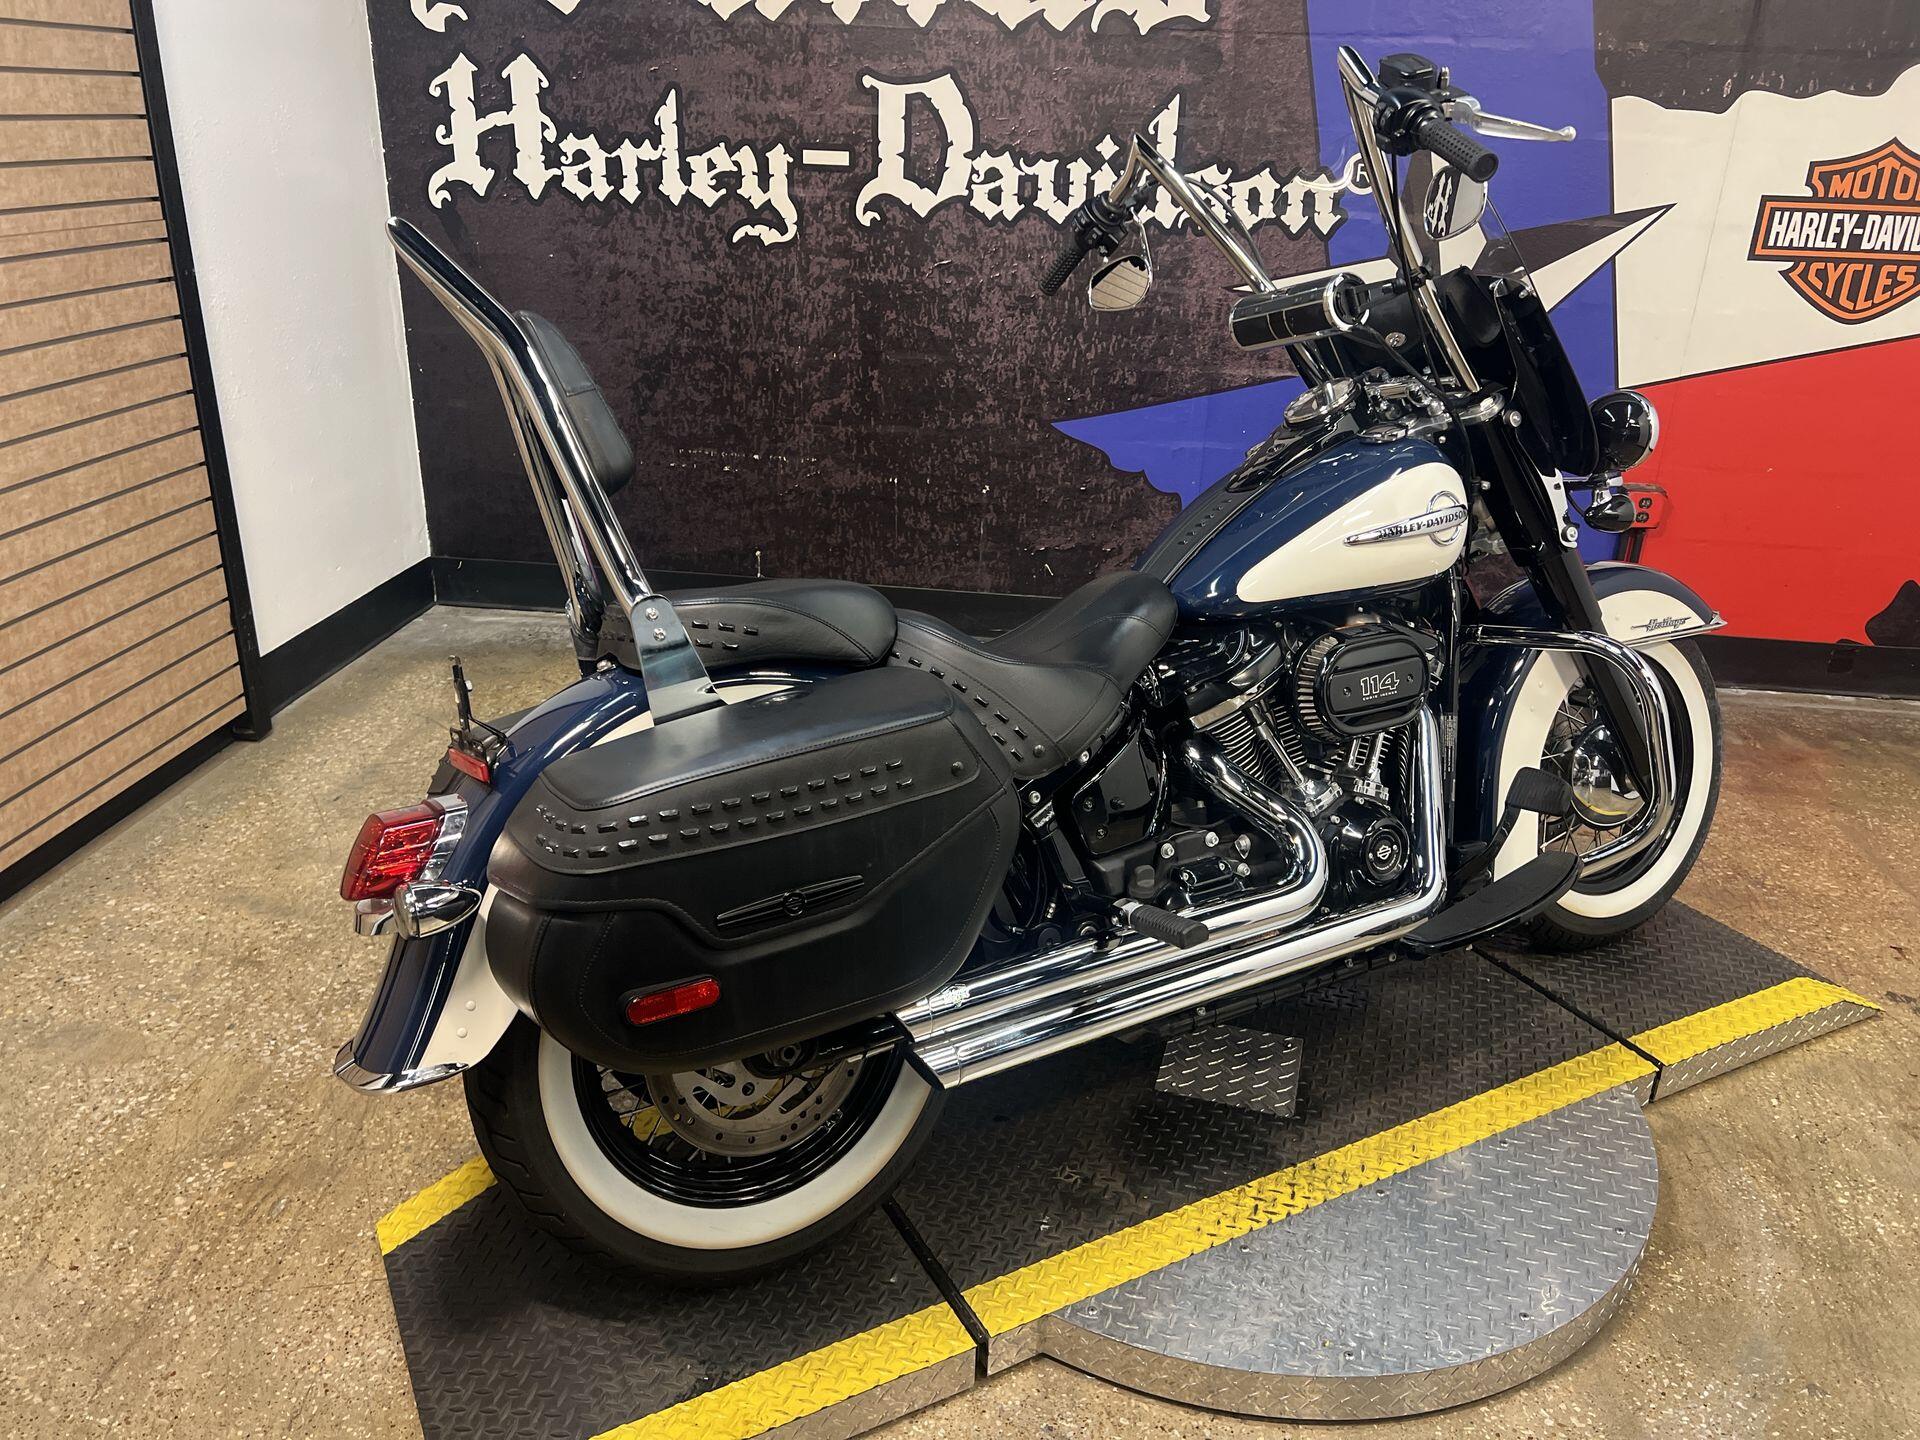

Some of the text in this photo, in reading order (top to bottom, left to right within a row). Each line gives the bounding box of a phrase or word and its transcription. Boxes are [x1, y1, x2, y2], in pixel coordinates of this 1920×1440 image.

[429, 52, 1343, 246] Harley-Davidson
[1829, 157, 1920, 200] MOTO
[1808, 262, 1917, 310] CYCLES
[1361, 671, 1400, 696] 114
